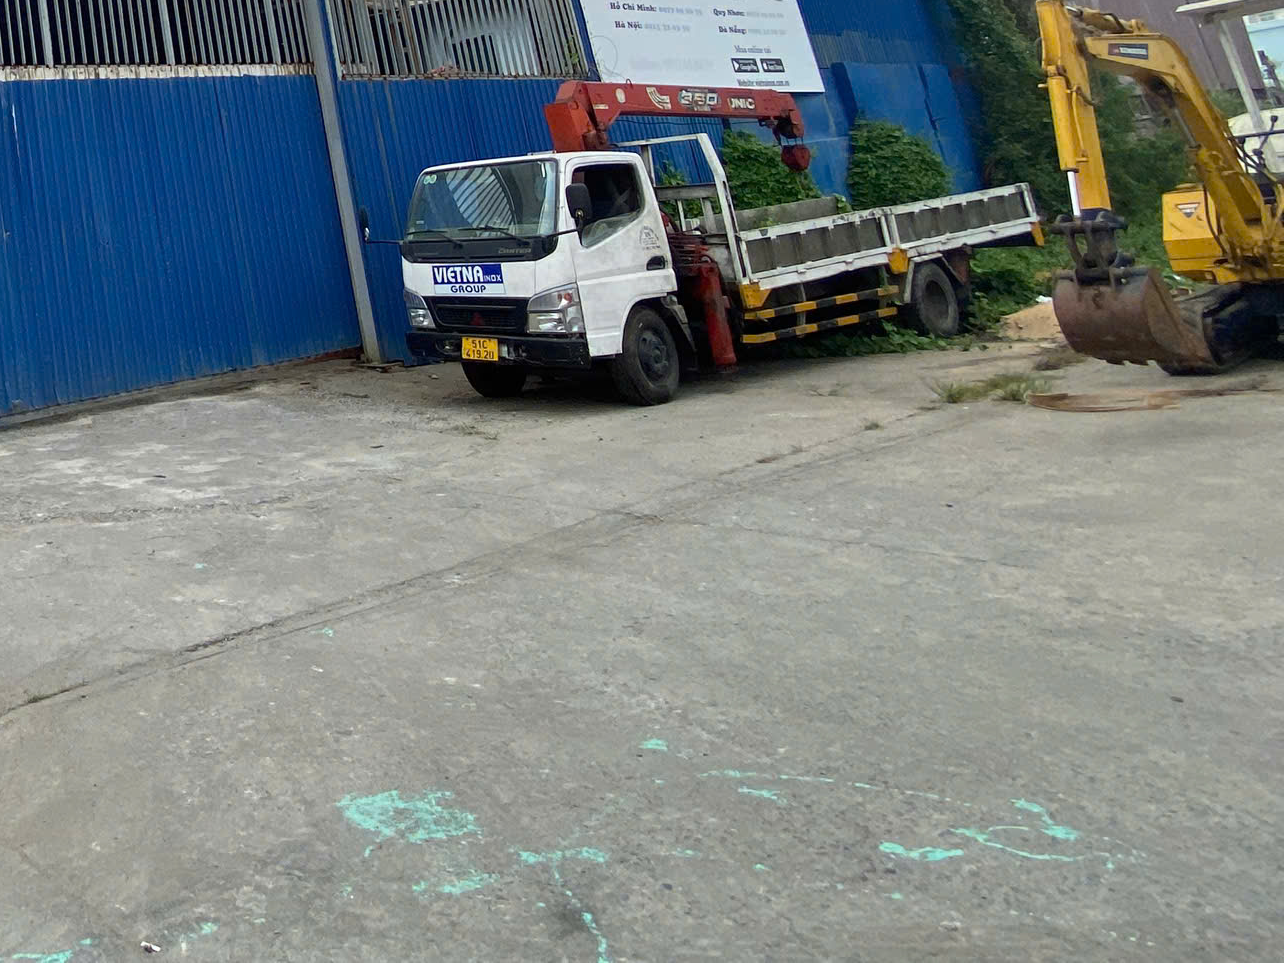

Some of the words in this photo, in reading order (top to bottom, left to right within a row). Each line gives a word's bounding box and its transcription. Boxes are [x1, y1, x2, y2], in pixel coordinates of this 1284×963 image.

[433, 266, 484, 283] VIETNA
[450, 285, 487, 293] GROUP
[471, 340, 488, 349] 51C
